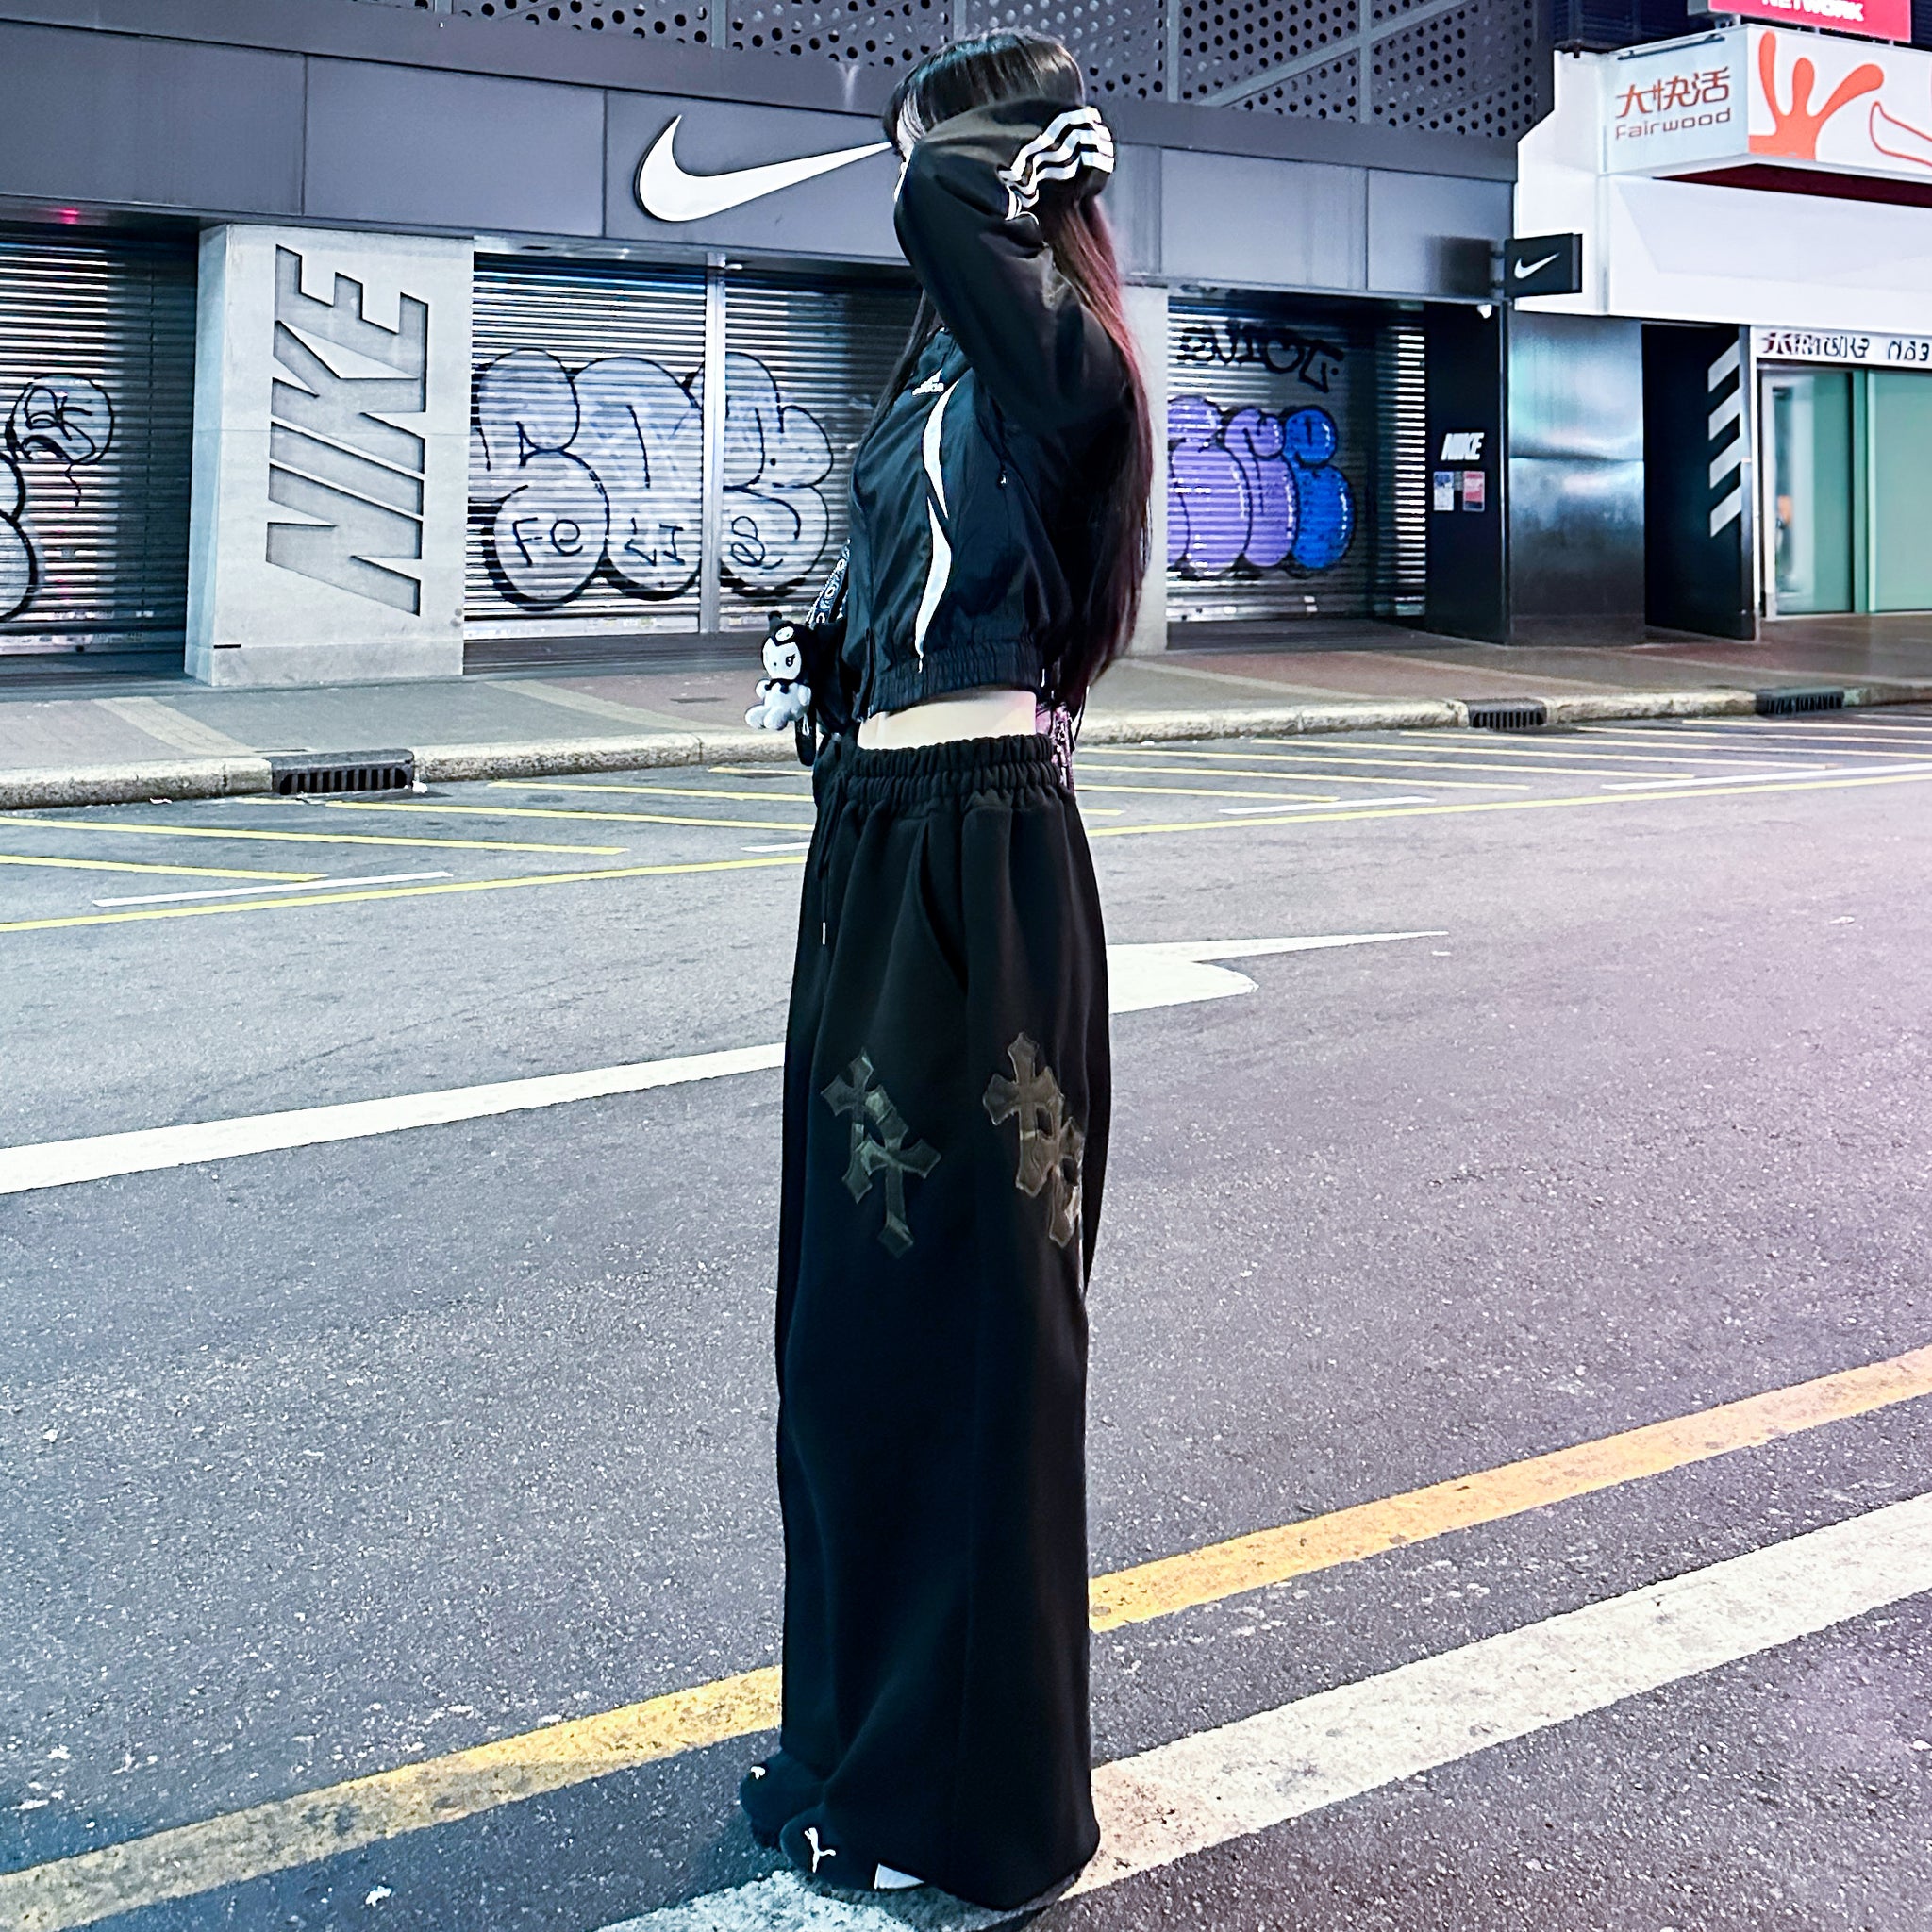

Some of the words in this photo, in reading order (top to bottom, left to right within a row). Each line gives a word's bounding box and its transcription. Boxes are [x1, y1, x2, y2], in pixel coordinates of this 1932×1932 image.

[1615, 65, 1730, 119] 大快活
[1615, 107, 1731, 140] Fairwood
[266, 243, 429, 617] NIKE
[1440, 432, 1485, 461] NIKE
